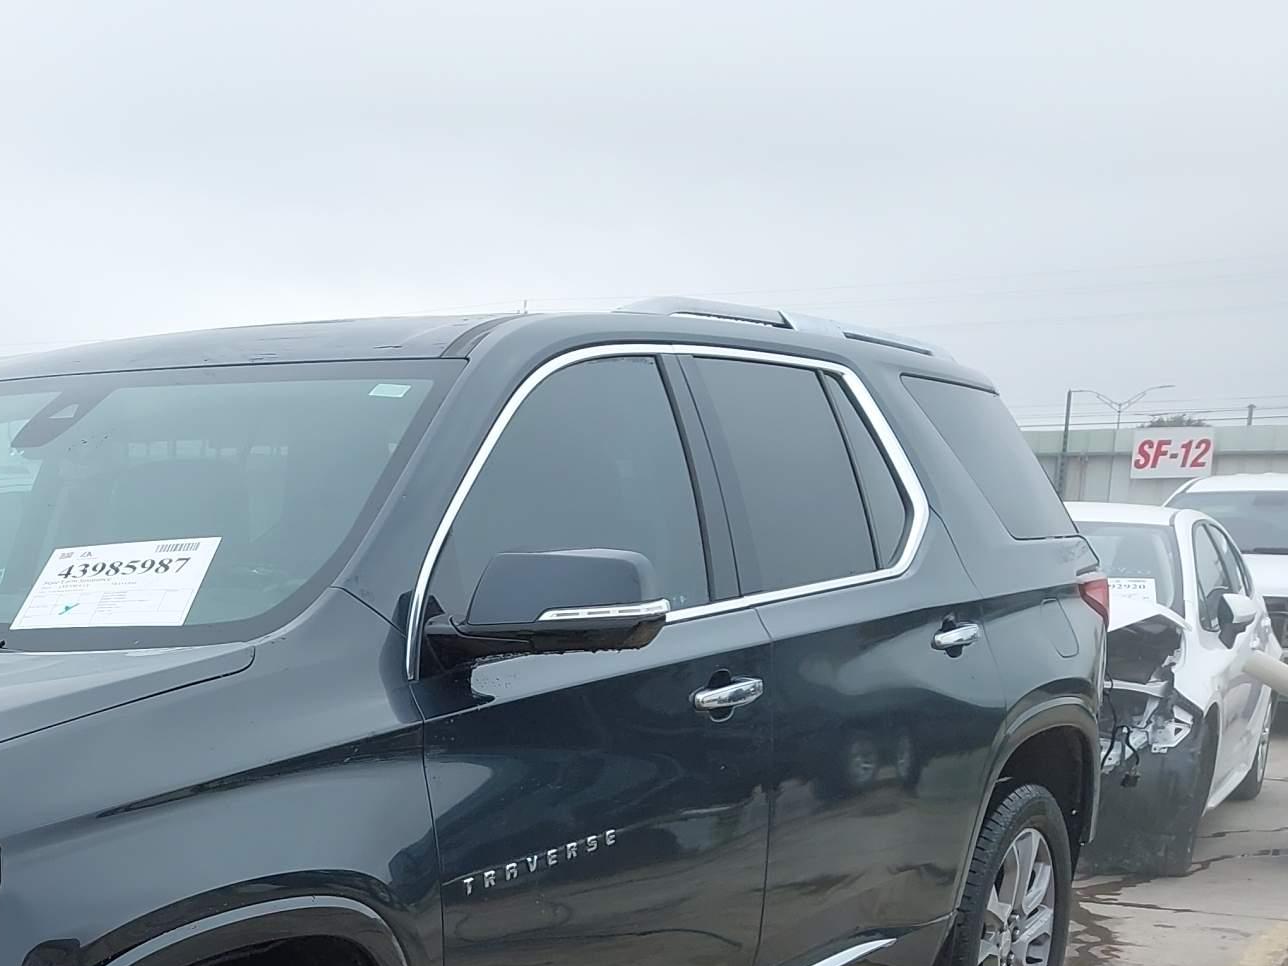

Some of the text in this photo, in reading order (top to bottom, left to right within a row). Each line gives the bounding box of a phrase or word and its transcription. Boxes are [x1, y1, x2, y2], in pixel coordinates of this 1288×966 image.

[1133, 438, 1212, 470] SF-12
[57, 557, 192, 579] 43985987
[463, 829, 616, 896] TRAVERSE
